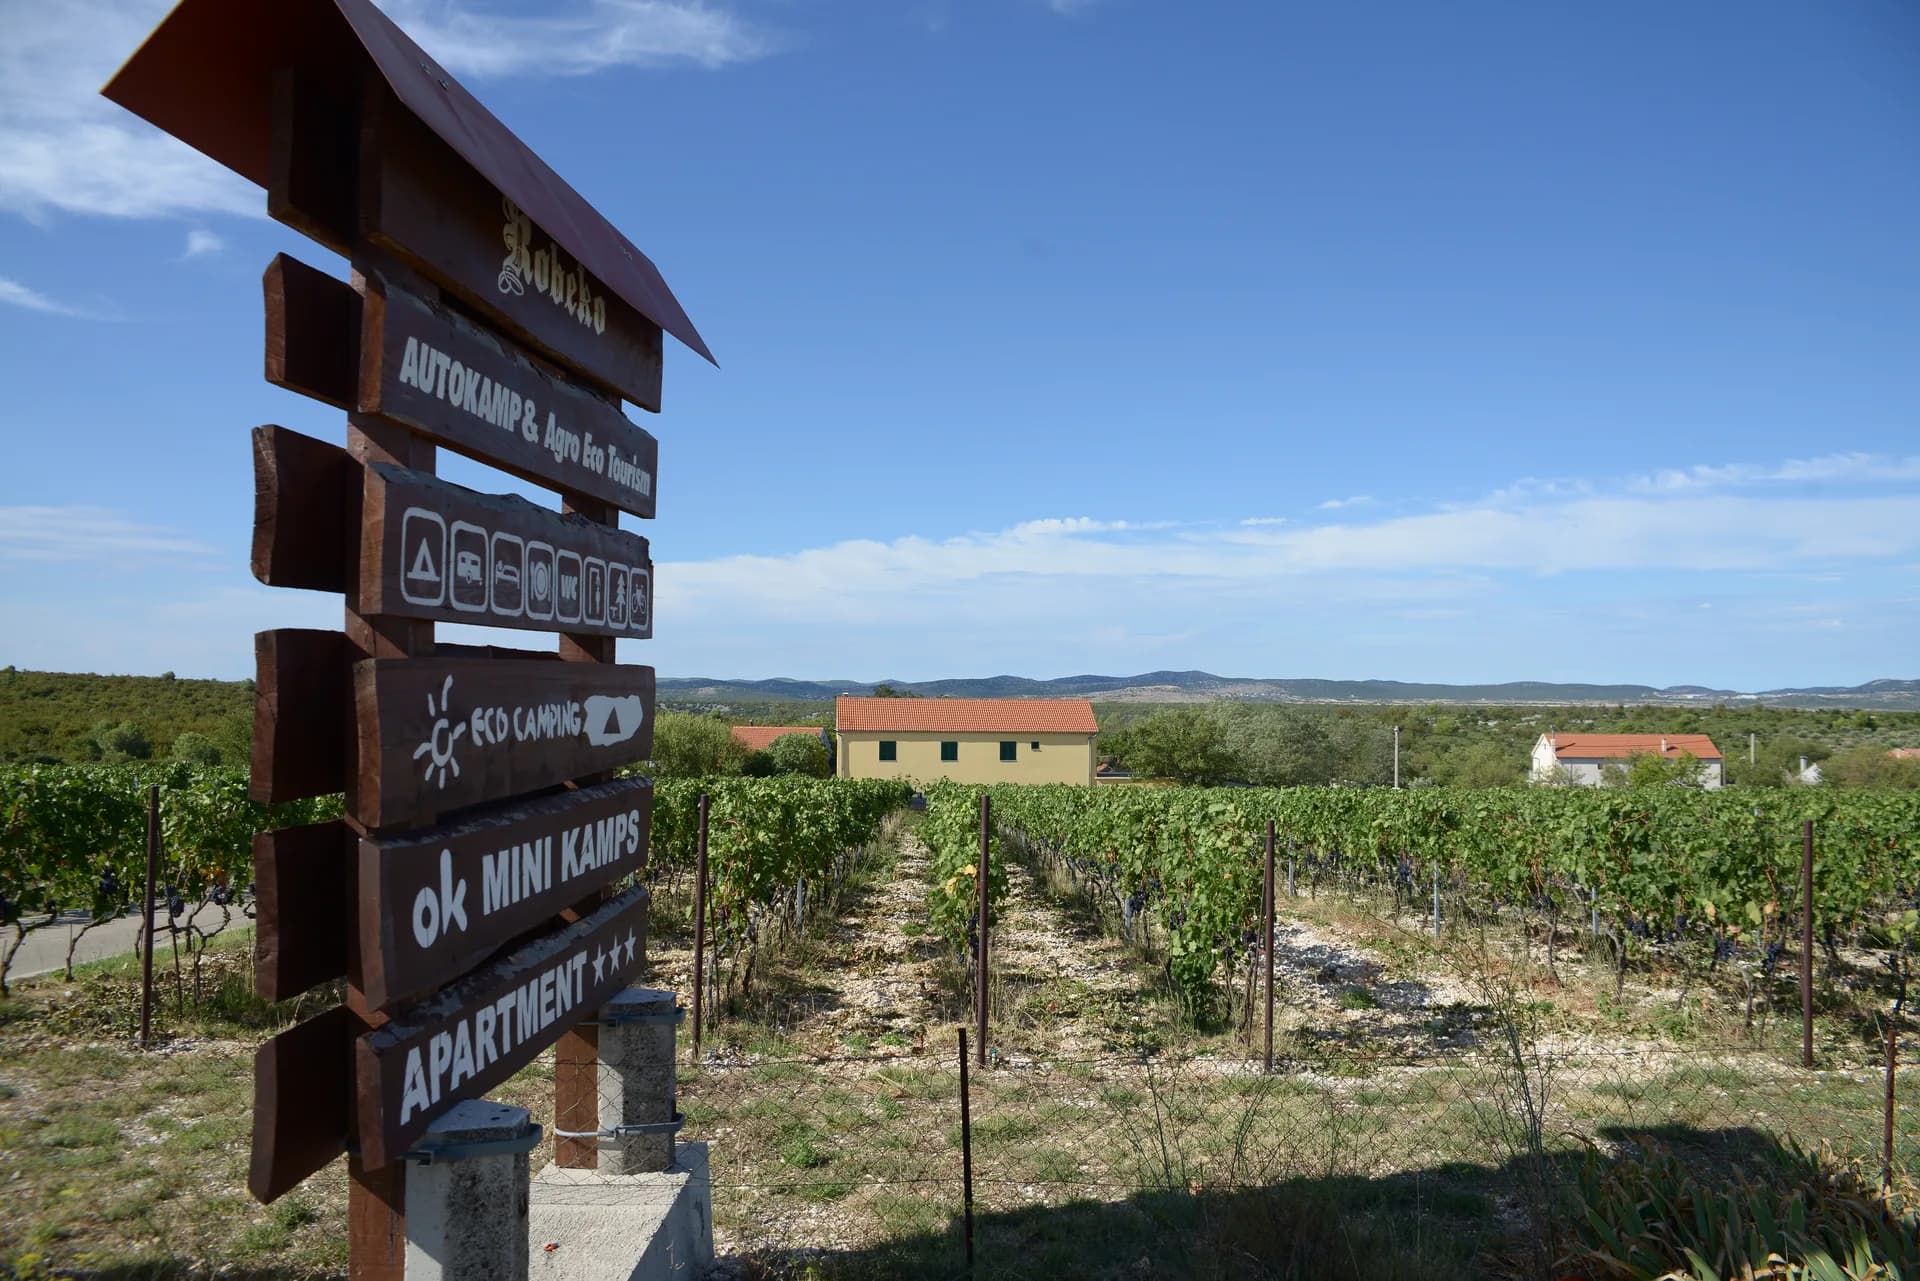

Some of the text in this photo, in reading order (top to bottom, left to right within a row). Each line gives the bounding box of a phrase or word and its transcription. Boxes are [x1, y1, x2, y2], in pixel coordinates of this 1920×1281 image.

[544, 412, 579, 463] Agro
[583, 432, 605, 475] Eco
[607, 444, 651, 497] Tourism
[560, 574, 579, 601] WC
[471, 700, 581, 746] ECO CAMPING
[482, 836, 552, 916] MINI
[561, 809, 640, 883] KAMPS
[400, 950, 587, 1126] APARTMENT
